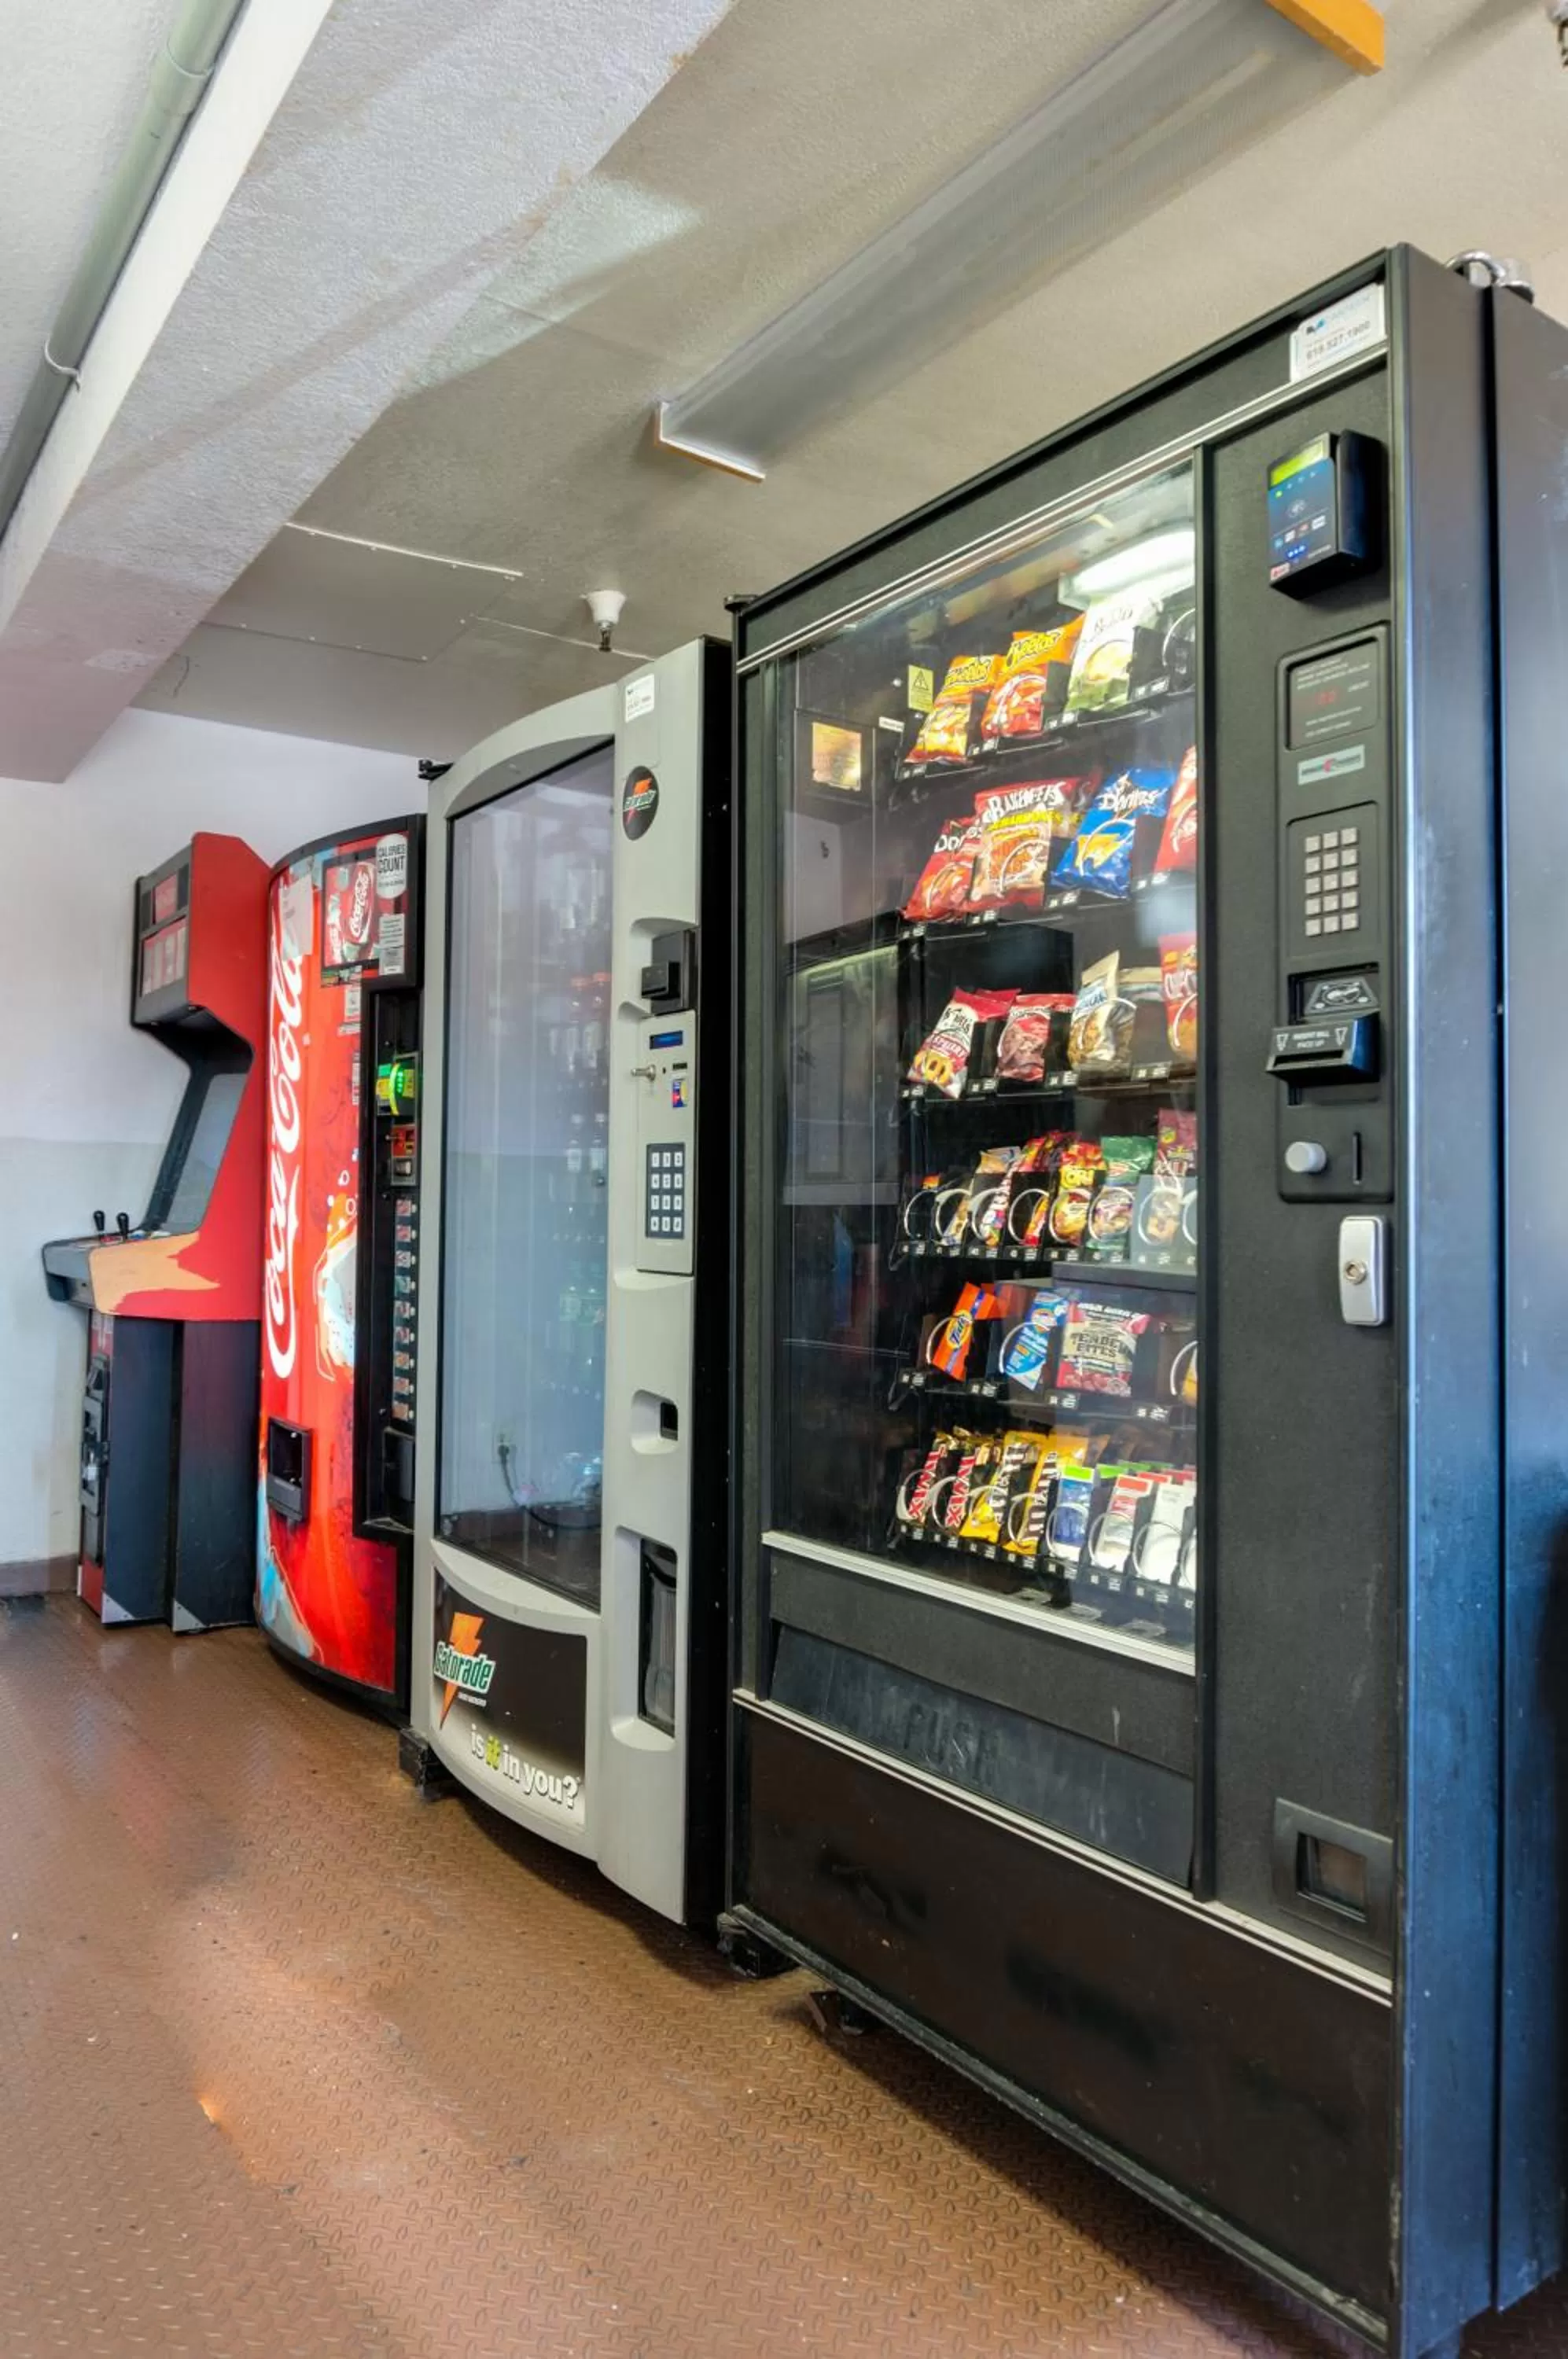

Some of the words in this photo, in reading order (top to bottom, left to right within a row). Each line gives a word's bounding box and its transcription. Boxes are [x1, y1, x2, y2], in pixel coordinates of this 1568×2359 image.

[378, 856, 404, 873] COUNT
[434, 1640, 495, 1693] Gatorade
[471, 1723, 485, 1759] is
[502, 1744, 521, 1783] in
[522, 1761, 580, 1809] you?
[903, 1703, 997, 1790] PUSH
